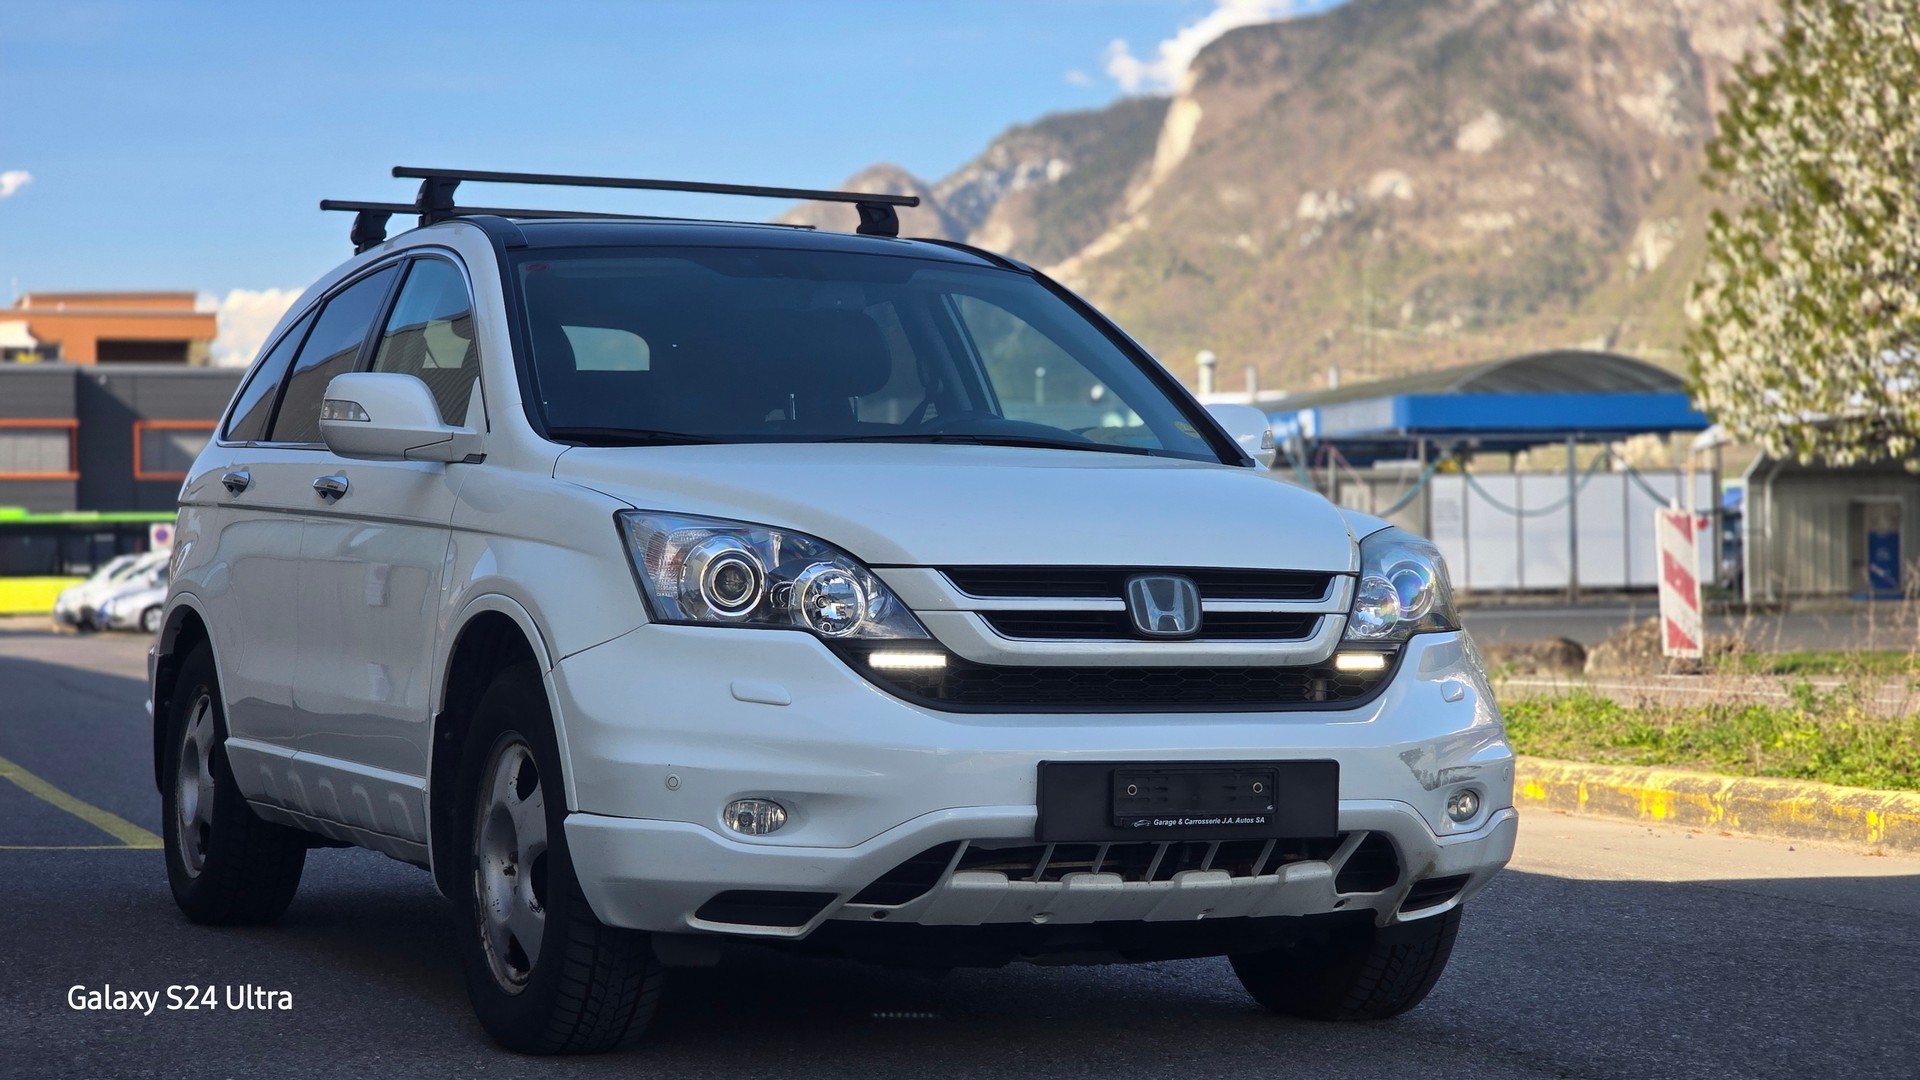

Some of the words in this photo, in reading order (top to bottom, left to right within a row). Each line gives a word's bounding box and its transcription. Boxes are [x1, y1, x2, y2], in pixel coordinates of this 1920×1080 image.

[1153, 818, 1177, 827] Garage
[1184, 817, 1221, 825] Carrosserie
[1235, 816, 1254, 824] Autos
[1255, 816, 1265, 824] SA
